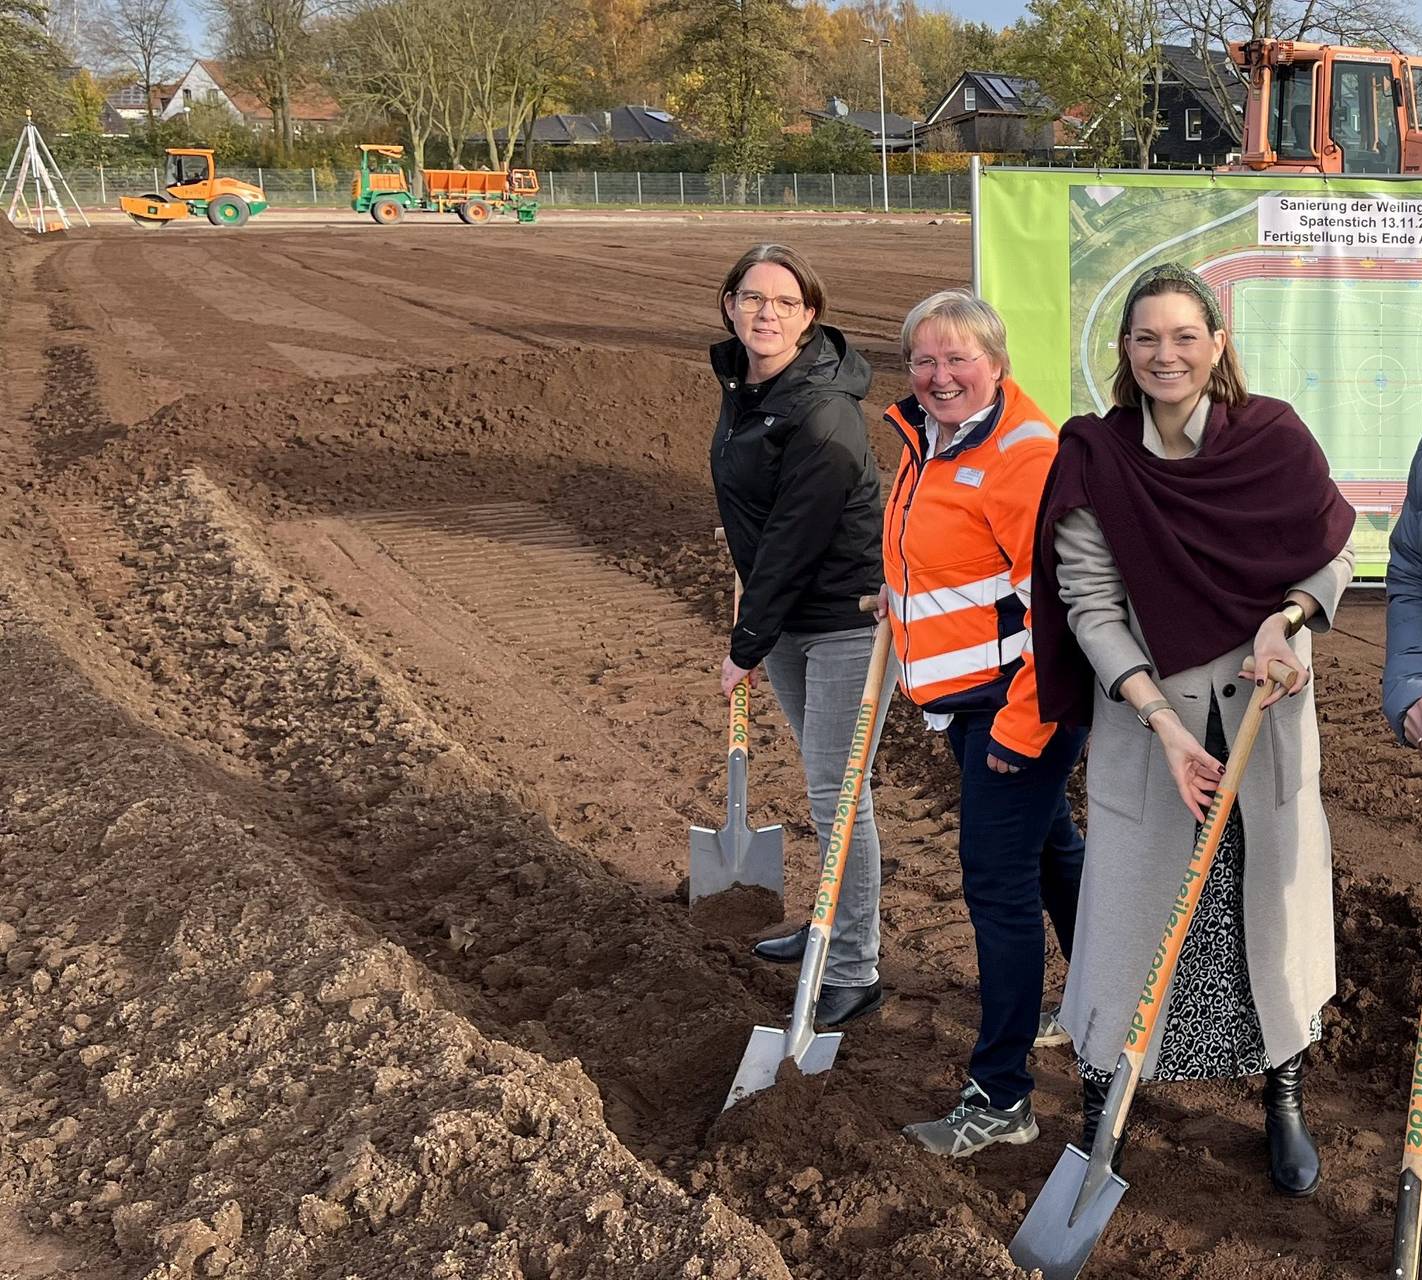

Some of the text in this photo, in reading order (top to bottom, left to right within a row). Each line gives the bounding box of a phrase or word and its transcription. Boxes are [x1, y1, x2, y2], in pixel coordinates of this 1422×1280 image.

[1280, 199, 1347, 214] Sanierung
[1351, 200, 1372, 213] der
[1299, 215, 1376, 229] Spatenstich
[1263, 230, 1354, 245] Fertigstellung
[1358, 232, 1377, 243] bis
[1382, 233, 1415, 245] Ende
[1126, 791, 1224, 1047] wwwheiler-sport.de
